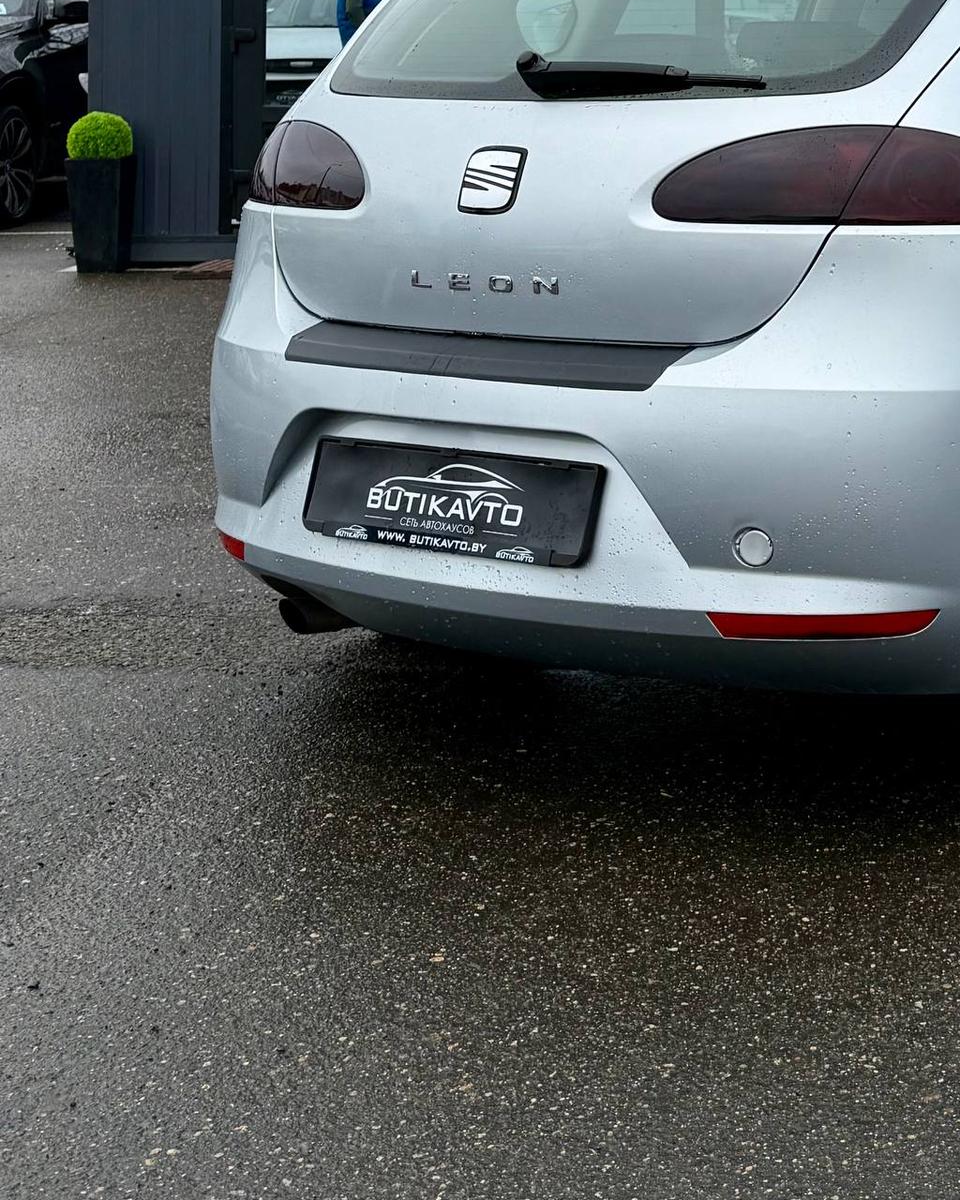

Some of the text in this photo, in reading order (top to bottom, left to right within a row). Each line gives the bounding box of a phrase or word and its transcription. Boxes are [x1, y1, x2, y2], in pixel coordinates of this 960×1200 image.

[410, 269, 559, 296] LEON
[366, 487, 524, 527] BUTIKAVTO
[400, 516, 475, 535] СЕТЬ АВТОХАУСОВ
[377, 530, 487, 553] WWW. BUTIKAVTO.BY
[495, 550, 534, 563] BUTIKAVTO
